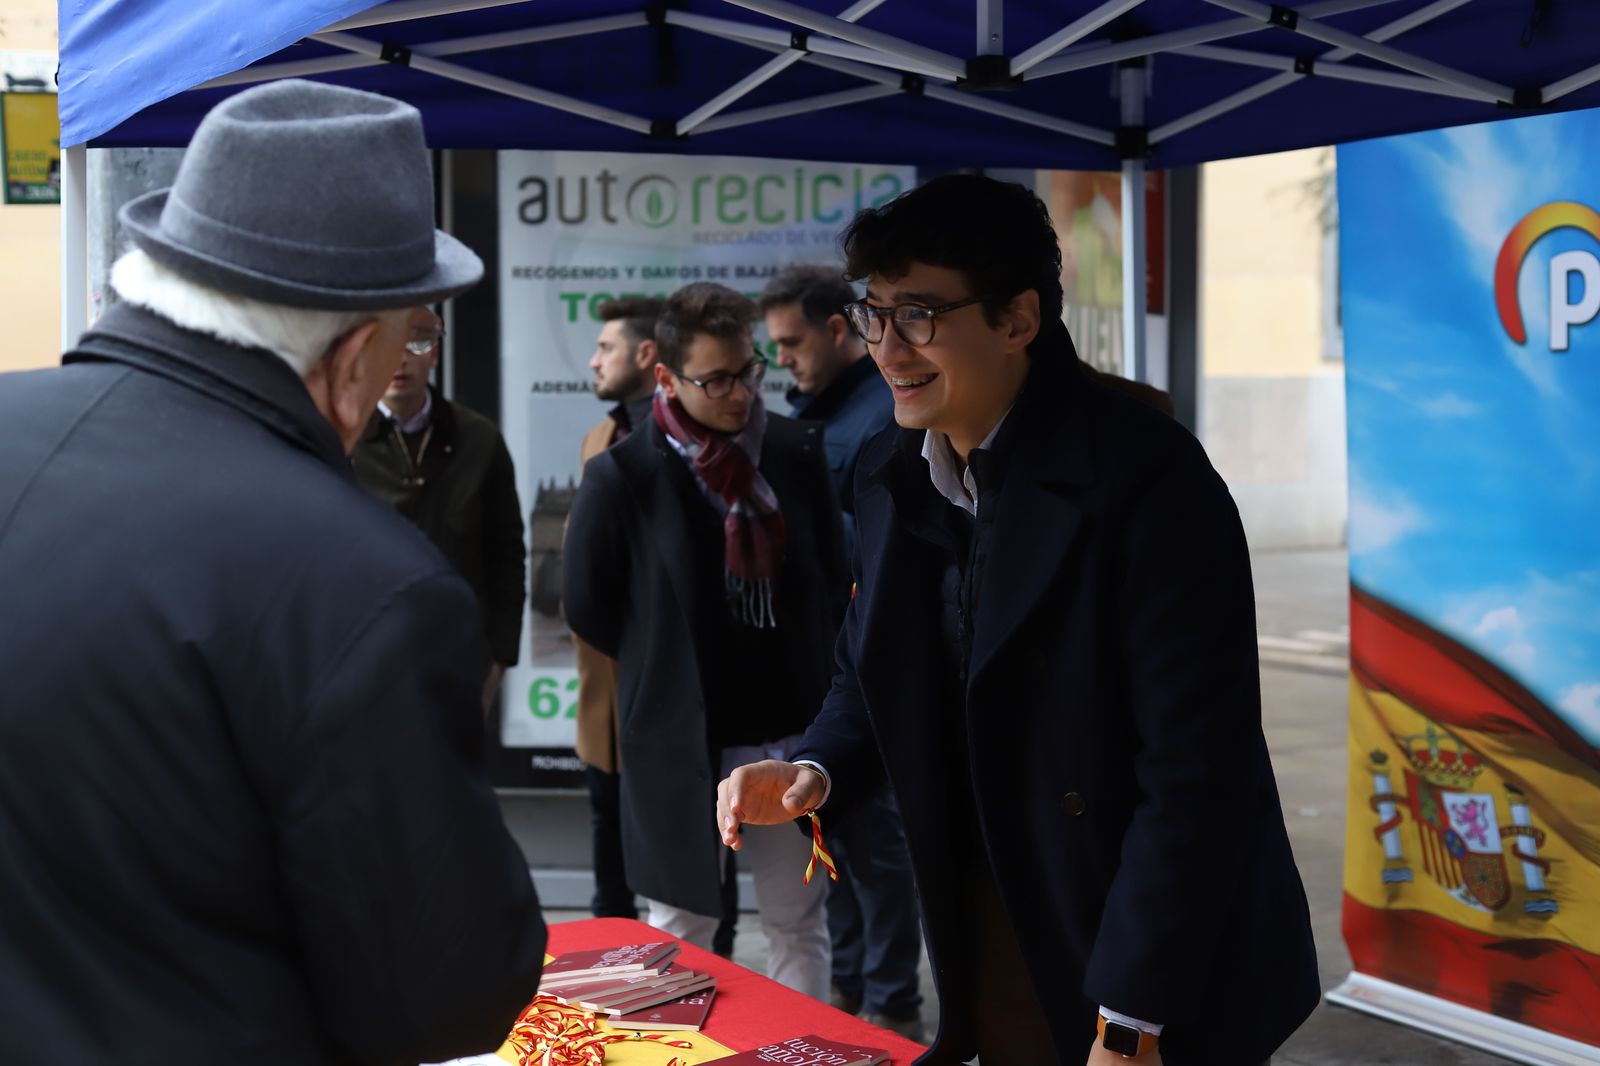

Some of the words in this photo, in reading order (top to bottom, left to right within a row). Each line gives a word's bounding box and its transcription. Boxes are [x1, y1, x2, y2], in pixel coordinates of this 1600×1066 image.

[512, 266, 619, 280] RECOGEMOS
[625, 267, 636, 280] Y
[641, 267, 701, 281] DAMOS
[707, 266, 730, 279] DE
[530, 380, 602, 395] ADEMÁ
[757, 1045, 822, 1066] añol
